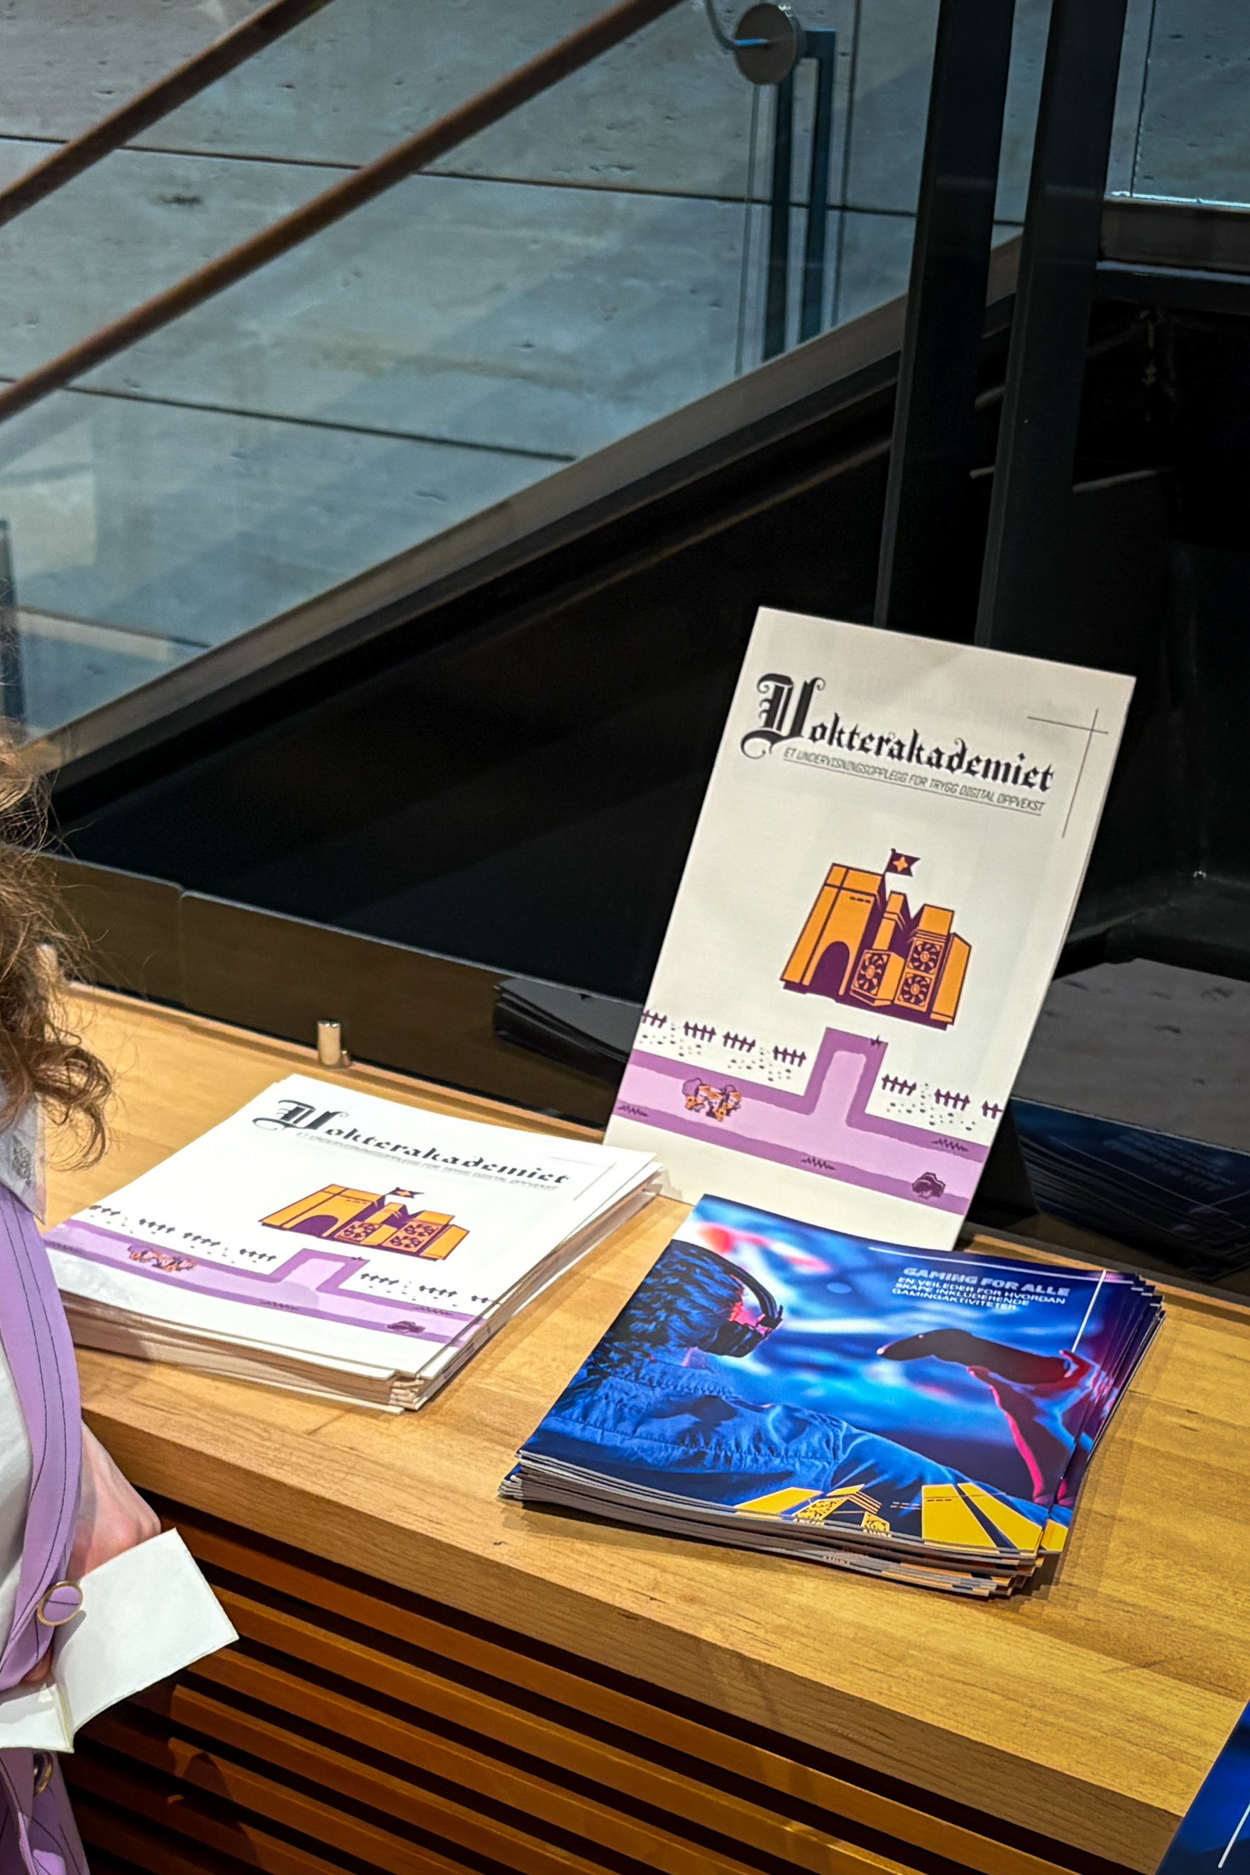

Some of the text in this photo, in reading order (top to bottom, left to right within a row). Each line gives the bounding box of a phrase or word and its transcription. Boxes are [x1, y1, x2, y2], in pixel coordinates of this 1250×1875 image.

[783, 747, 796, 758] ET
[910, 774, 928, 788] FOR
[930, 778, 959, 793] TRYGG
[959, 785, 994, 803] DIGITAL
[996, 793, 1046, 812] OPPVEKST
[895, 1282, 1030, 1307] SKAPE INKLUDERENDE
[897, 1276, 1066, 1305] EN VEILEDER FOR HVORDAN
[903, 1267, 1070, 1297] GAMING FOR ALLE
